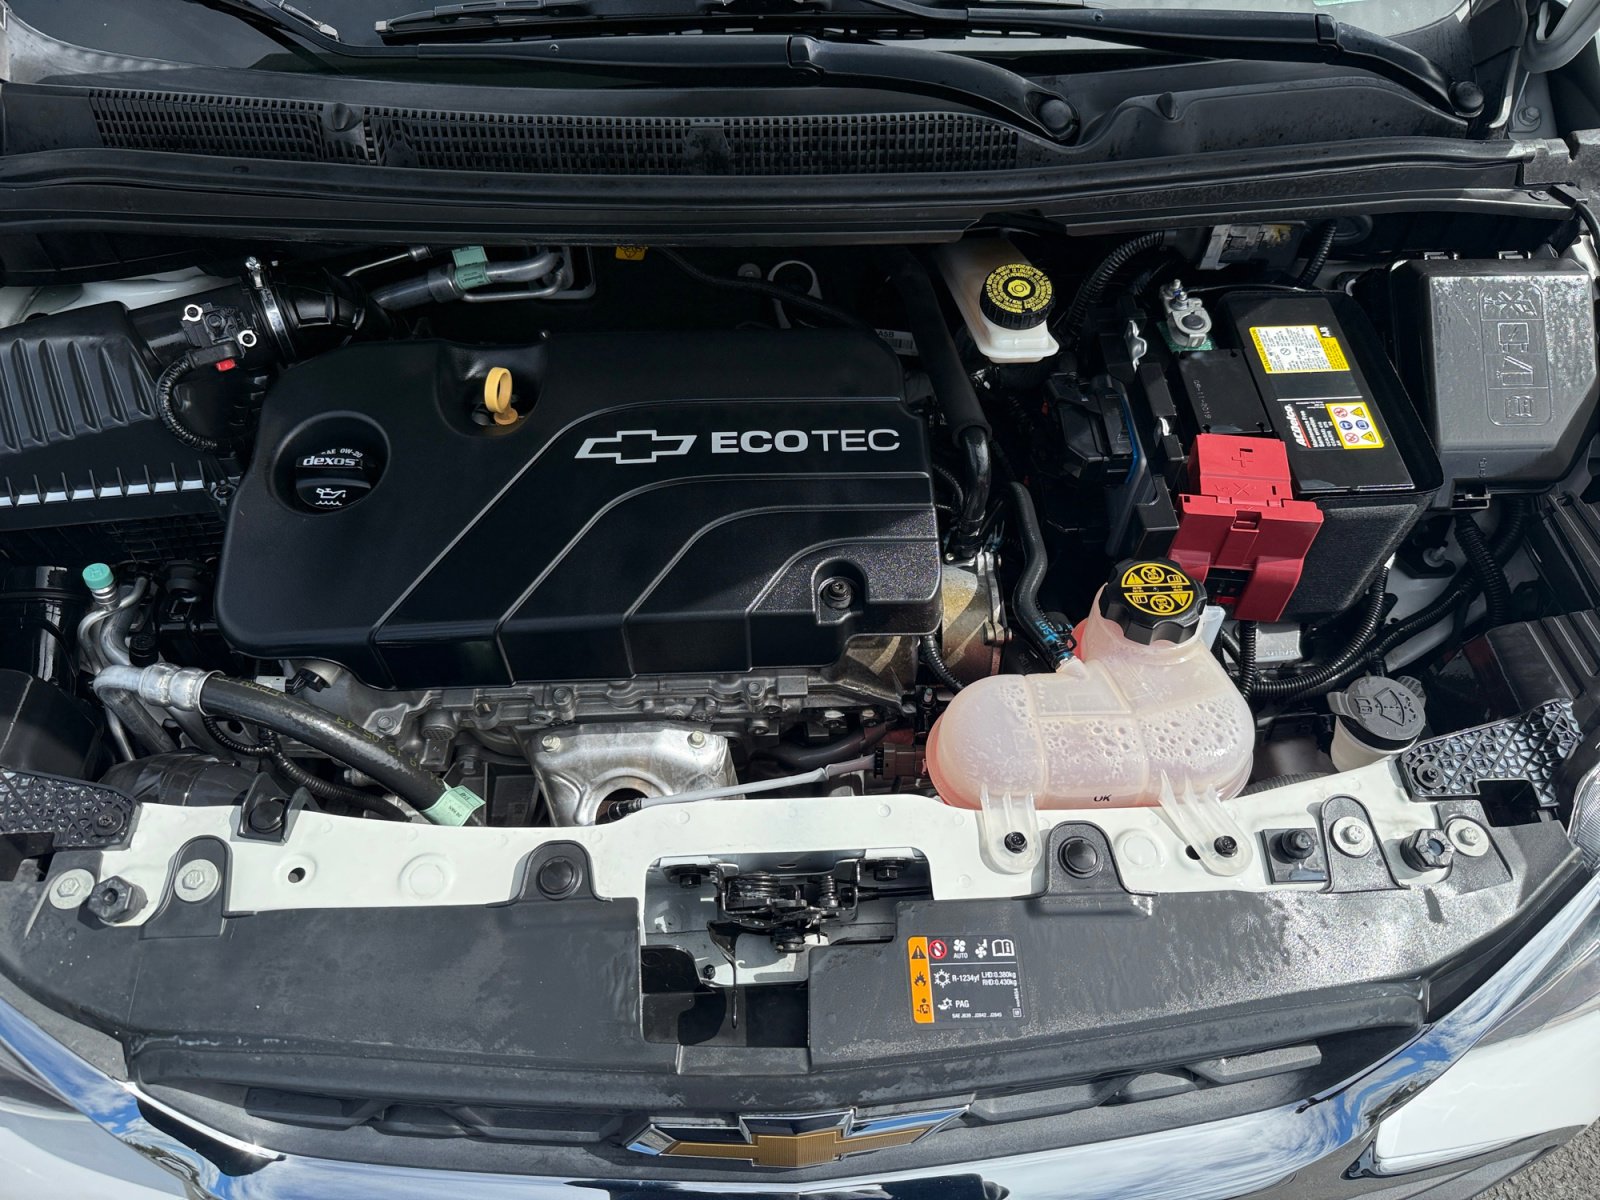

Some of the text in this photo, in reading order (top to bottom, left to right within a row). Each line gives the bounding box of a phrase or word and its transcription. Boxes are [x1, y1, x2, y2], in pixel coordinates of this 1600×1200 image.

[711, 429, 900, 453] ECOTEC
[303, 455, 356, 466] dexos
[952, 974, 980, 983] R-1234yf
[955, 1000, 970, 1008] PAG
